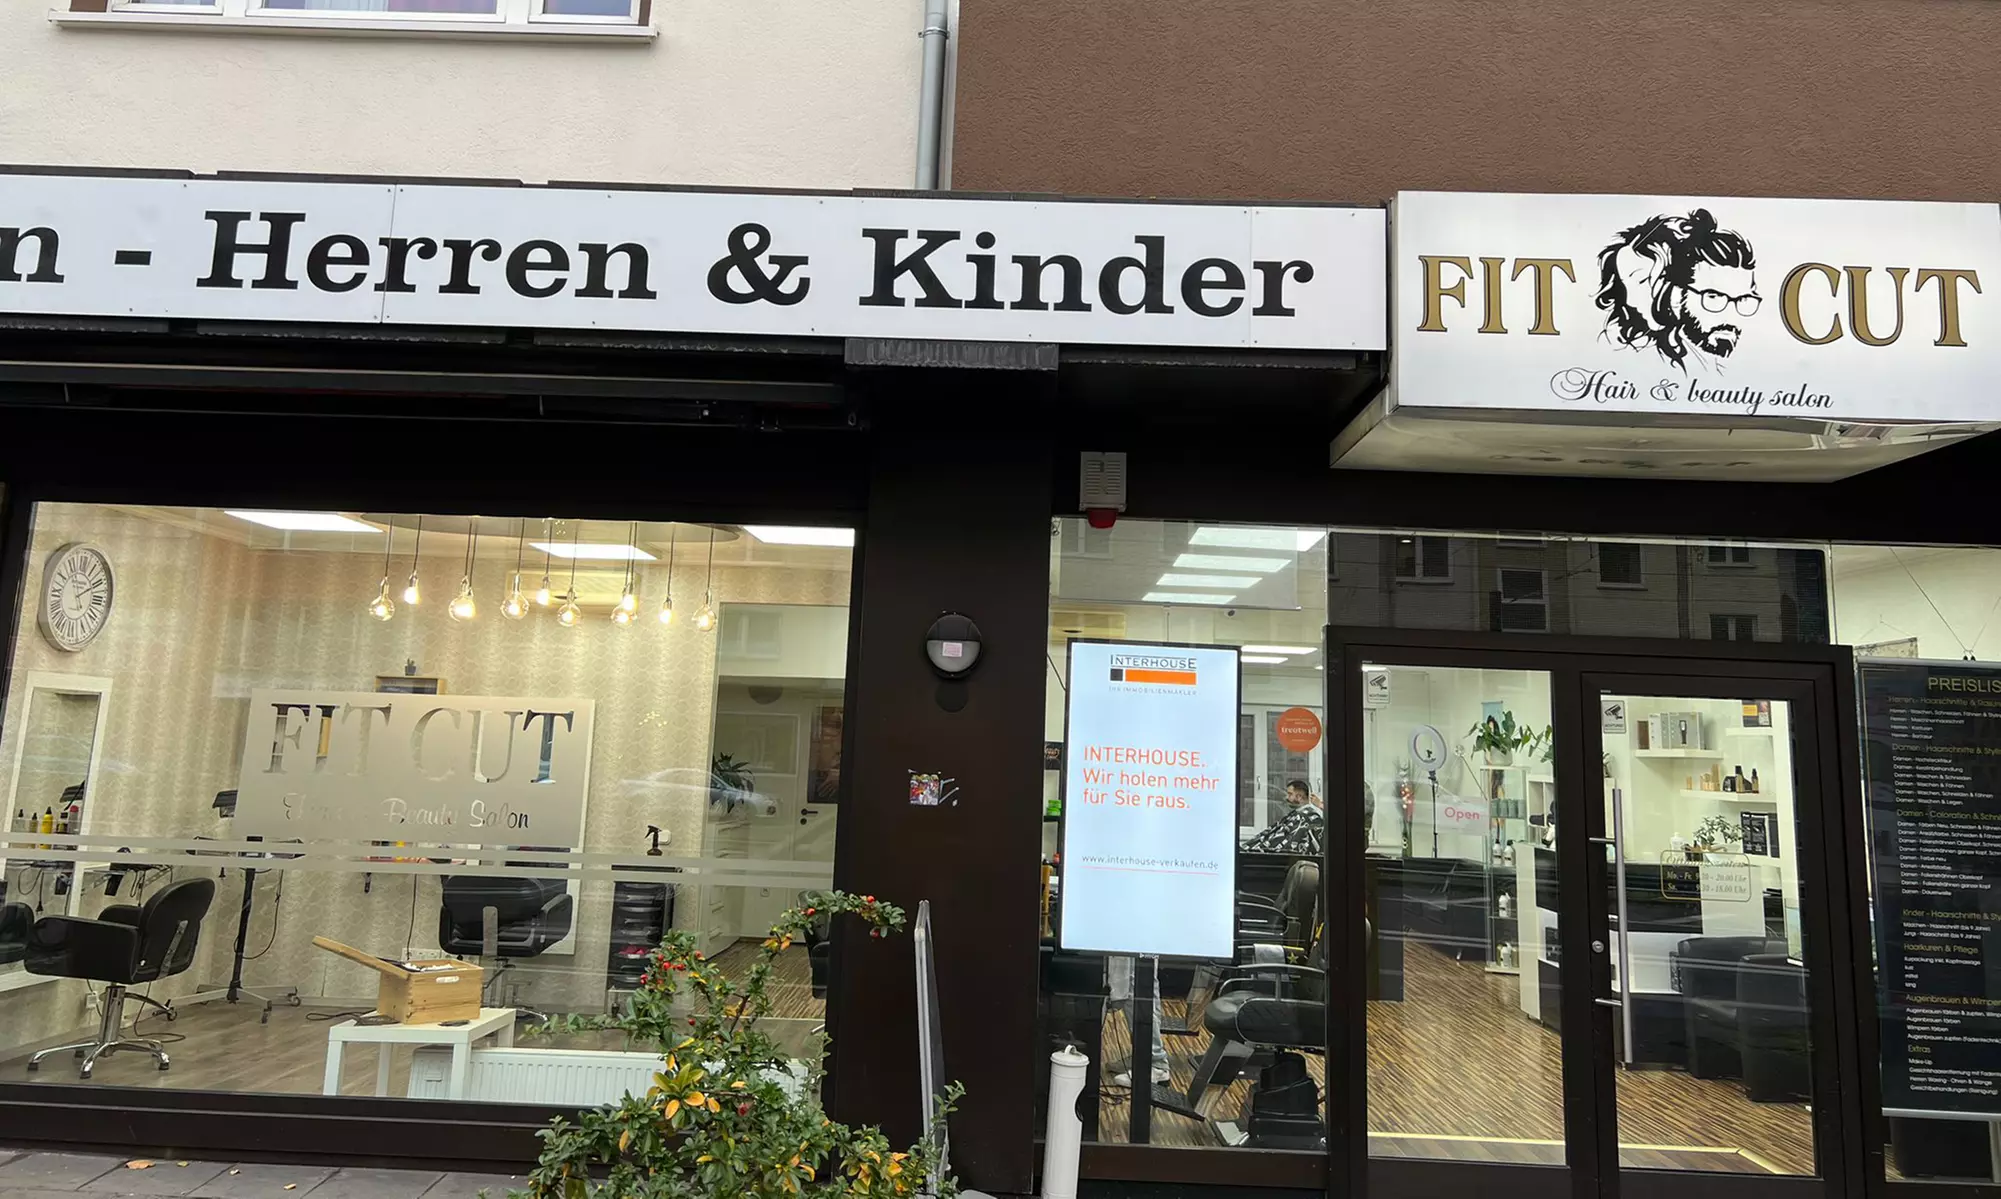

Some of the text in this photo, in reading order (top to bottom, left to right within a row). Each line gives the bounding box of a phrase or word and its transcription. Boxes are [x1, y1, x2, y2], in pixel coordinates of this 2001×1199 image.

[0, 209, 1315, 318] n - Herren & Kinder
[1417, 253, 1577, 336] FIT
[1778, 261, 1983, 348] CUT
[1549, 366, 1835, 416] Hair & beauty salon
[1110, 653, 1197, 669] INTERHOUSE
[1928, 676, 2001, 693] PREISLIS
[262, 701, 575, 785] FIT CUT
[1083, 746, 1207, 768] INTERHOUSE.
[1082, 768, 1220, 792] Wir holen mehr
[1082, 788, 1191, 809] für Sie raus.
[469, 799, 530, 829] Salon
[1444, 806, 1481, 822] Open
[1930, 810, 1972, 820] Coloration
[1081, 854, 1220, 870] www.interhouse-verkaufen.de
[1904, 944, 1944, 952] Haarkuren
[1906, 994, 1962, 1004] Augenbrauen
[1908, 1044, 1931, 1054] Extras
